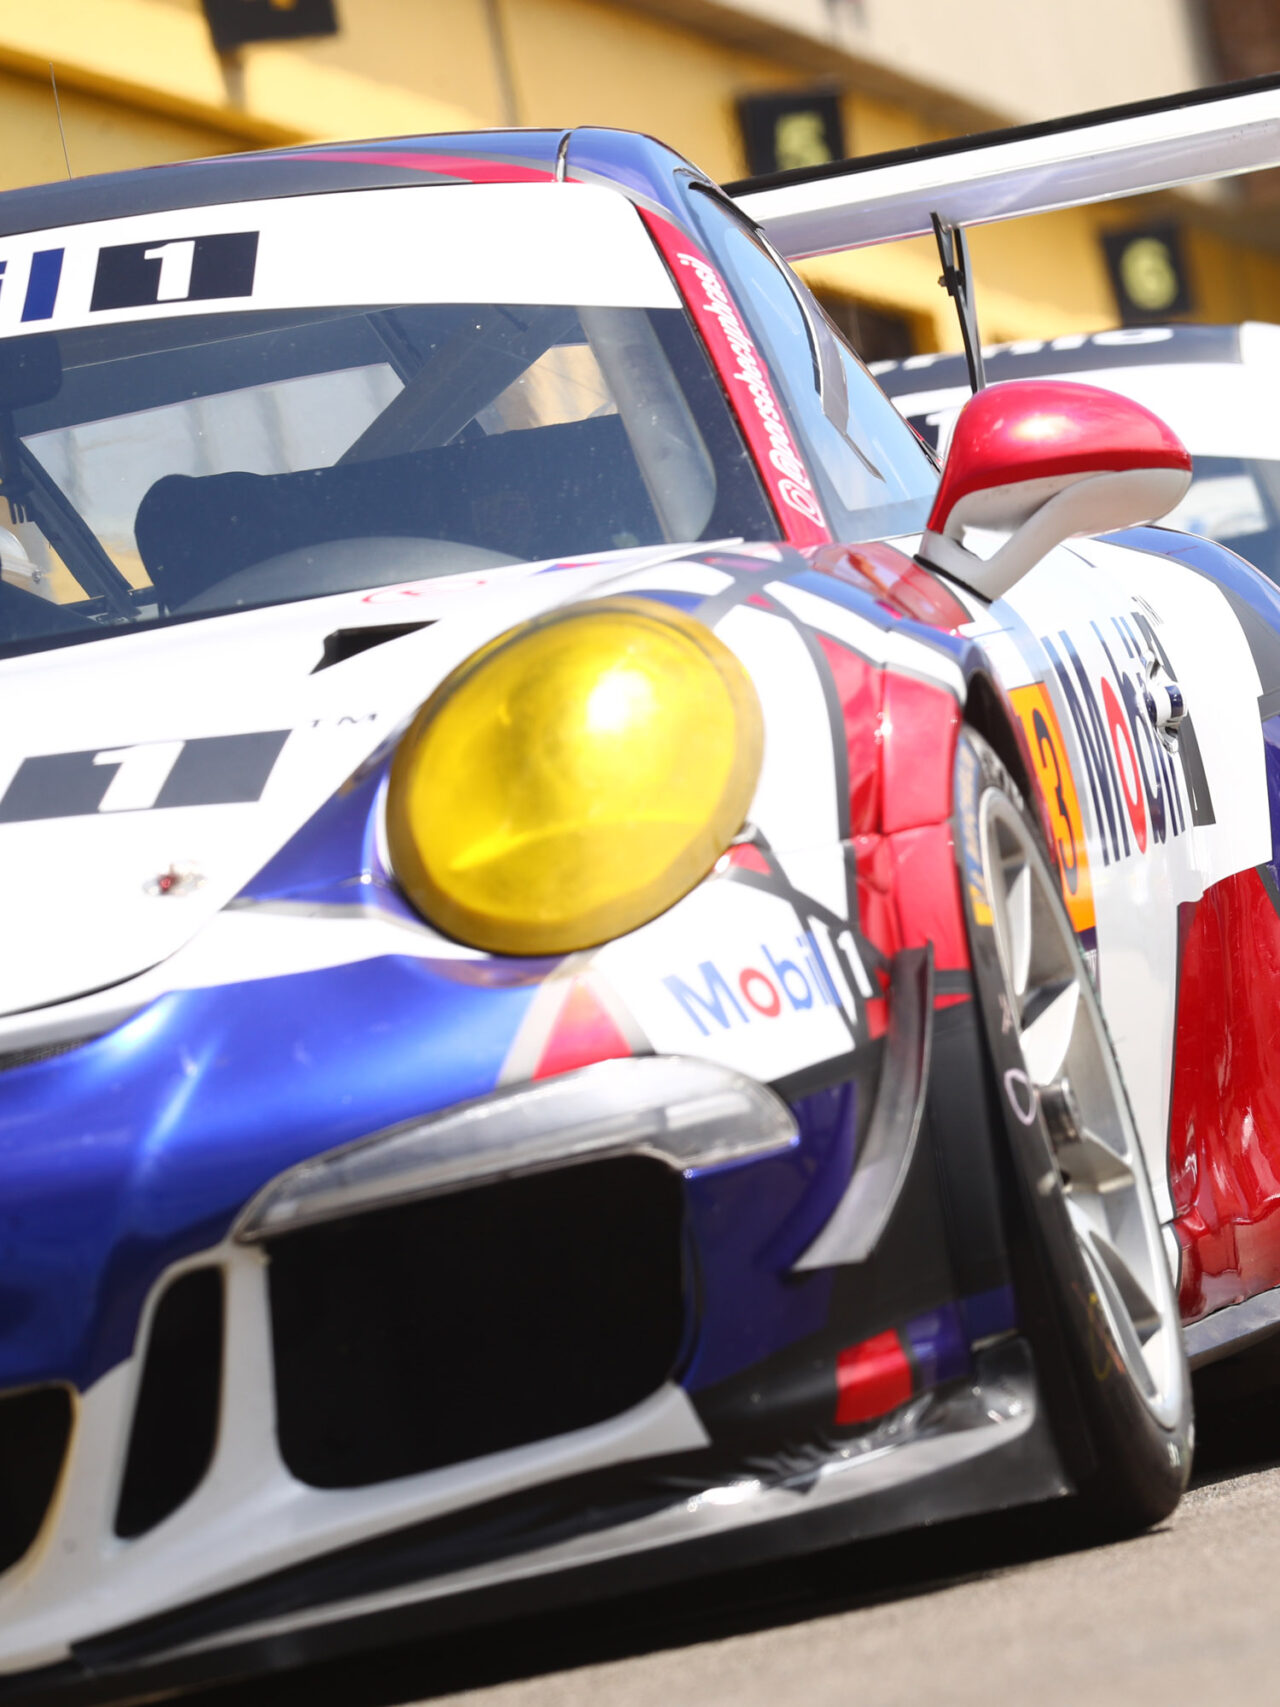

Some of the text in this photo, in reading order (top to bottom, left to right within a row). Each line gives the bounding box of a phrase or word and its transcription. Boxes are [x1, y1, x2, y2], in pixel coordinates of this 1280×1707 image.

[144, 240, 196, 302] 1
[1121, 237, 1178, 310] 6
[92, 739, 186, 814] 1
[1040, 616, 1187, 867] Mobil
[1031, 707, 1080, 896] 3
[661, 929, 874, 1037] Mobil 1
